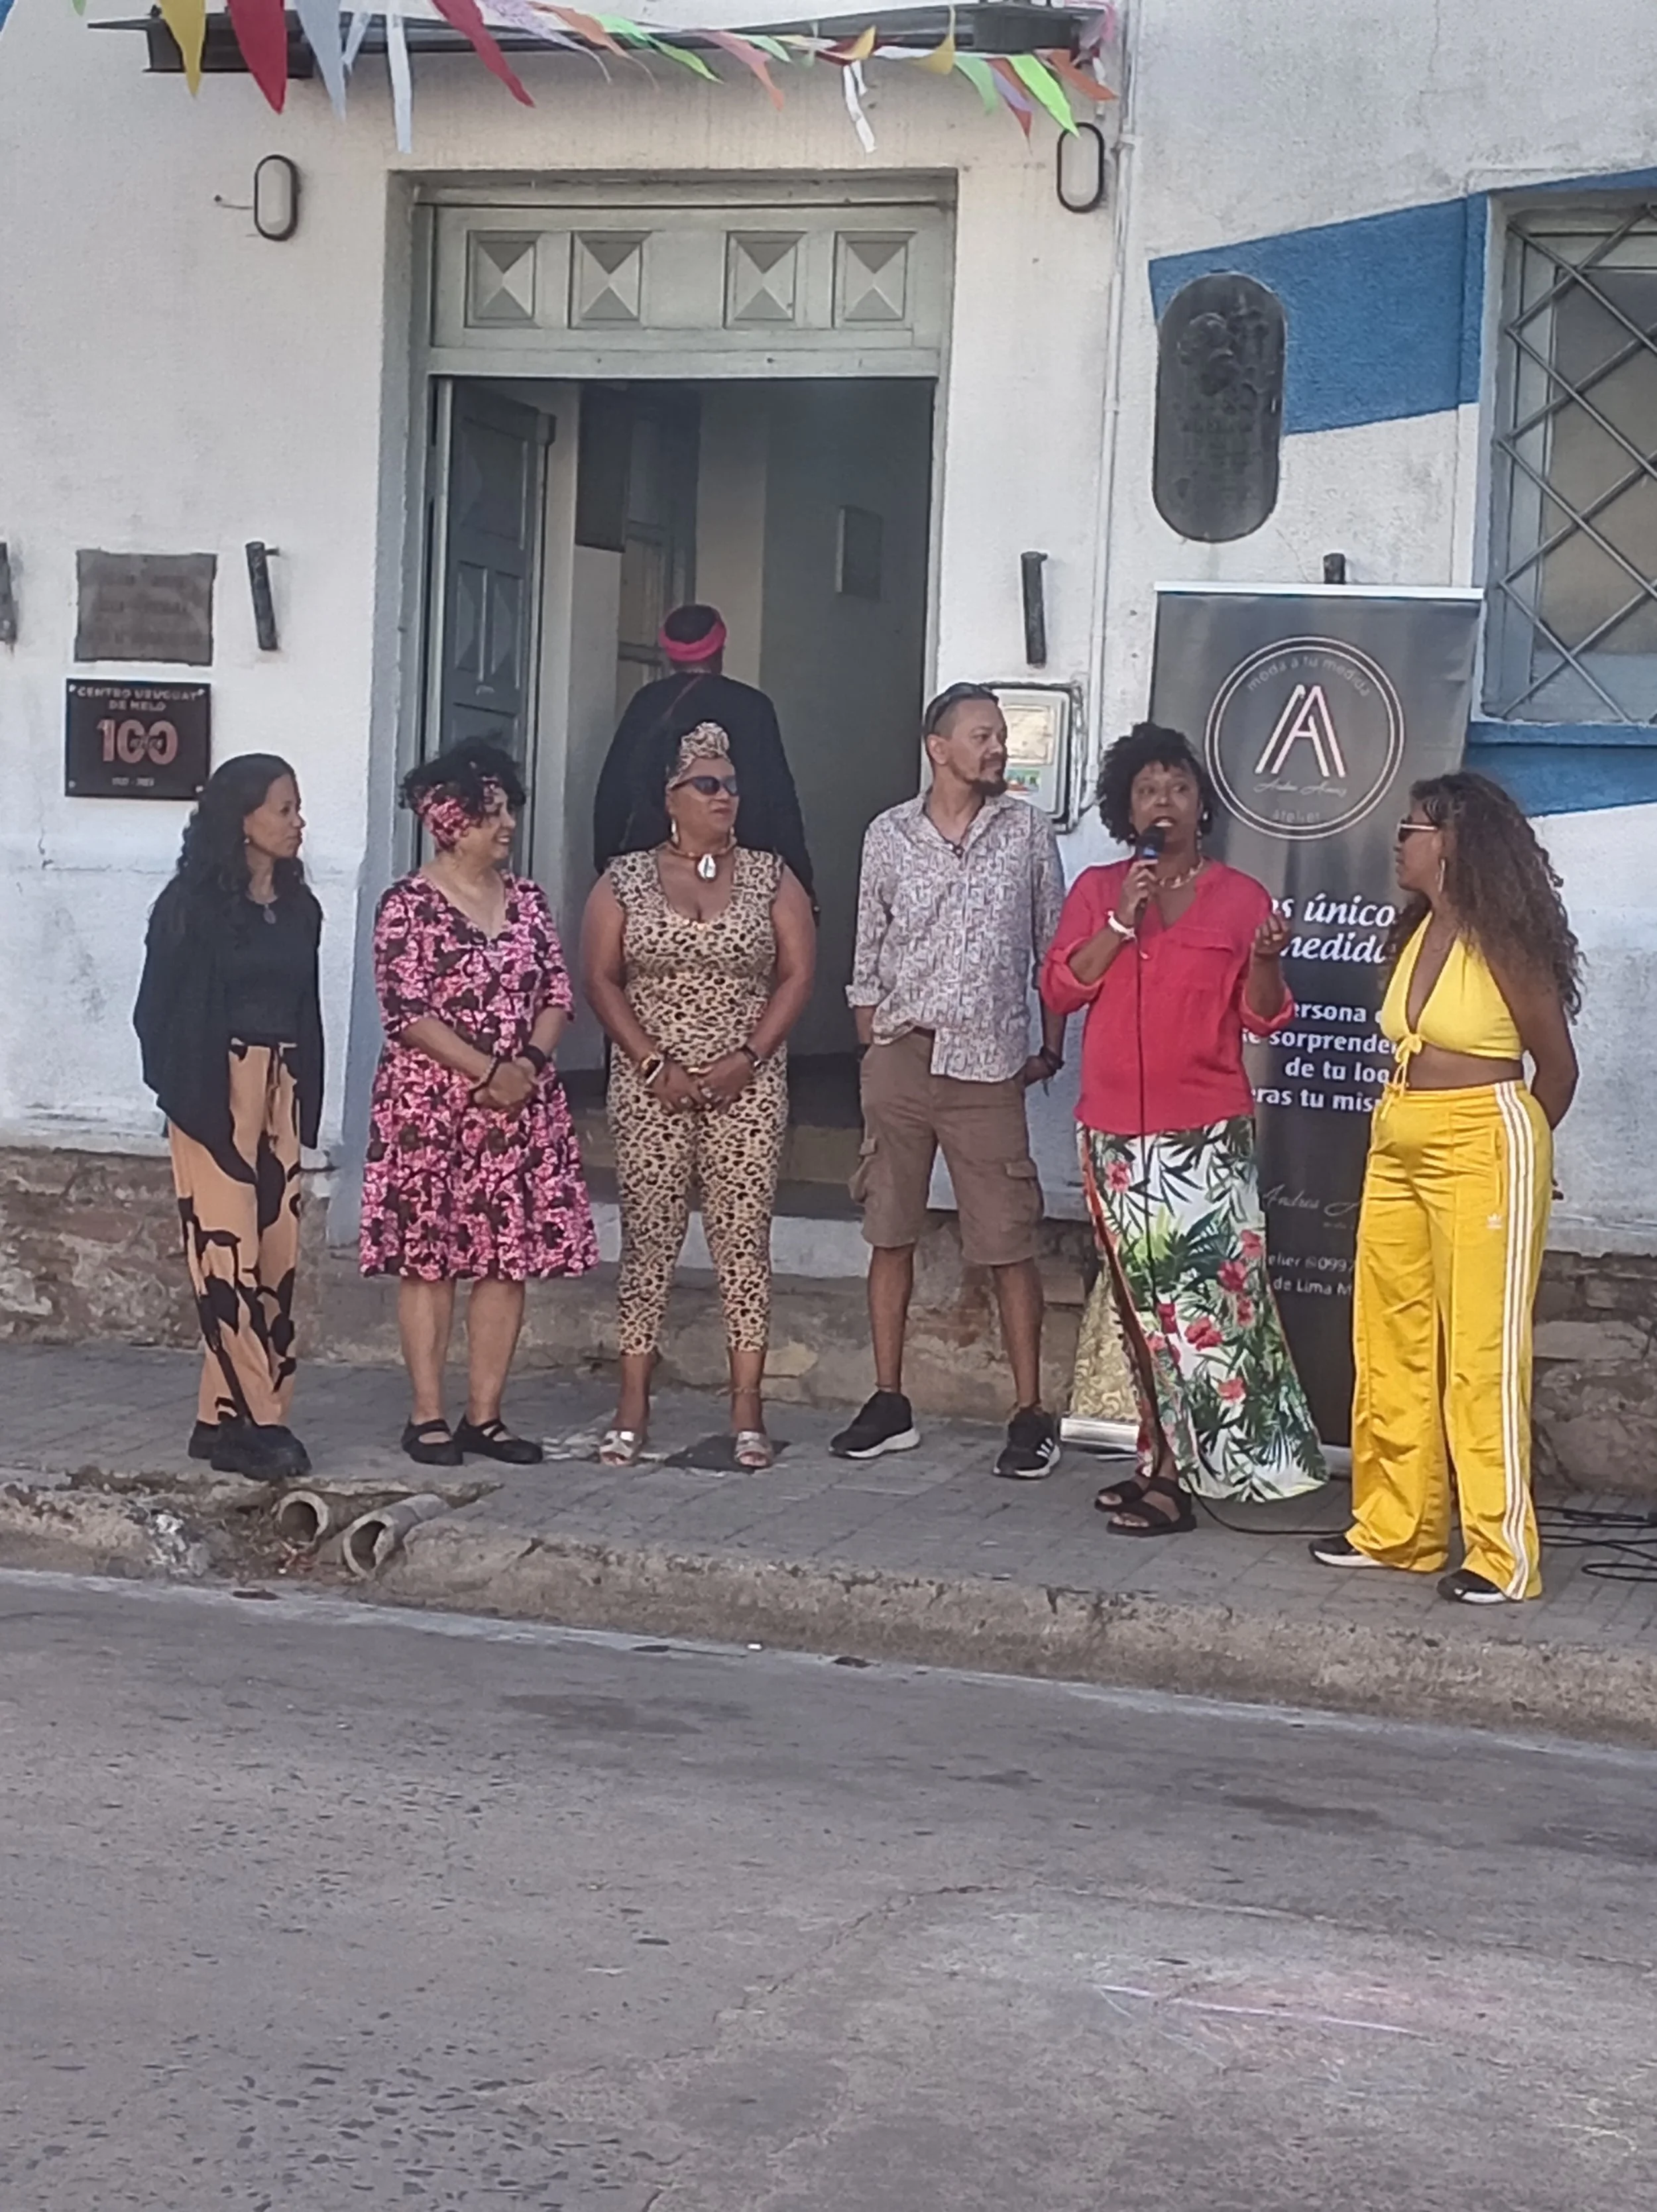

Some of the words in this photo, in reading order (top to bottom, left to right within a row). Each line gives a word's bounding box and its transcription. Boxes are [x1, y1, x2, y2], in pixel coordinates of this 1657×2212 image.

[1247, 662, 1287, 692] moda
[1323, 659, 1371, 696] medida
[77, 686, 131, 698] CENTRO
[109, 700, 127, 710] DE
[130, 700, 167, 712] MELO
[96, 719, 178, 765] 100
[1303, 893, 1397, 926] único
[1285, 1056, 1315, 1078] de
[1323, 1060, 1346, 1080] tu
[1354, 1061, 1390, 1083] loo
[1300, 1088, 1324, 1109] tu
[1268, 1252, 1302, 1267] elier
[1273, 1276, 1292, 1292] de
[1296, 1278, 1332, 1295] Lima
